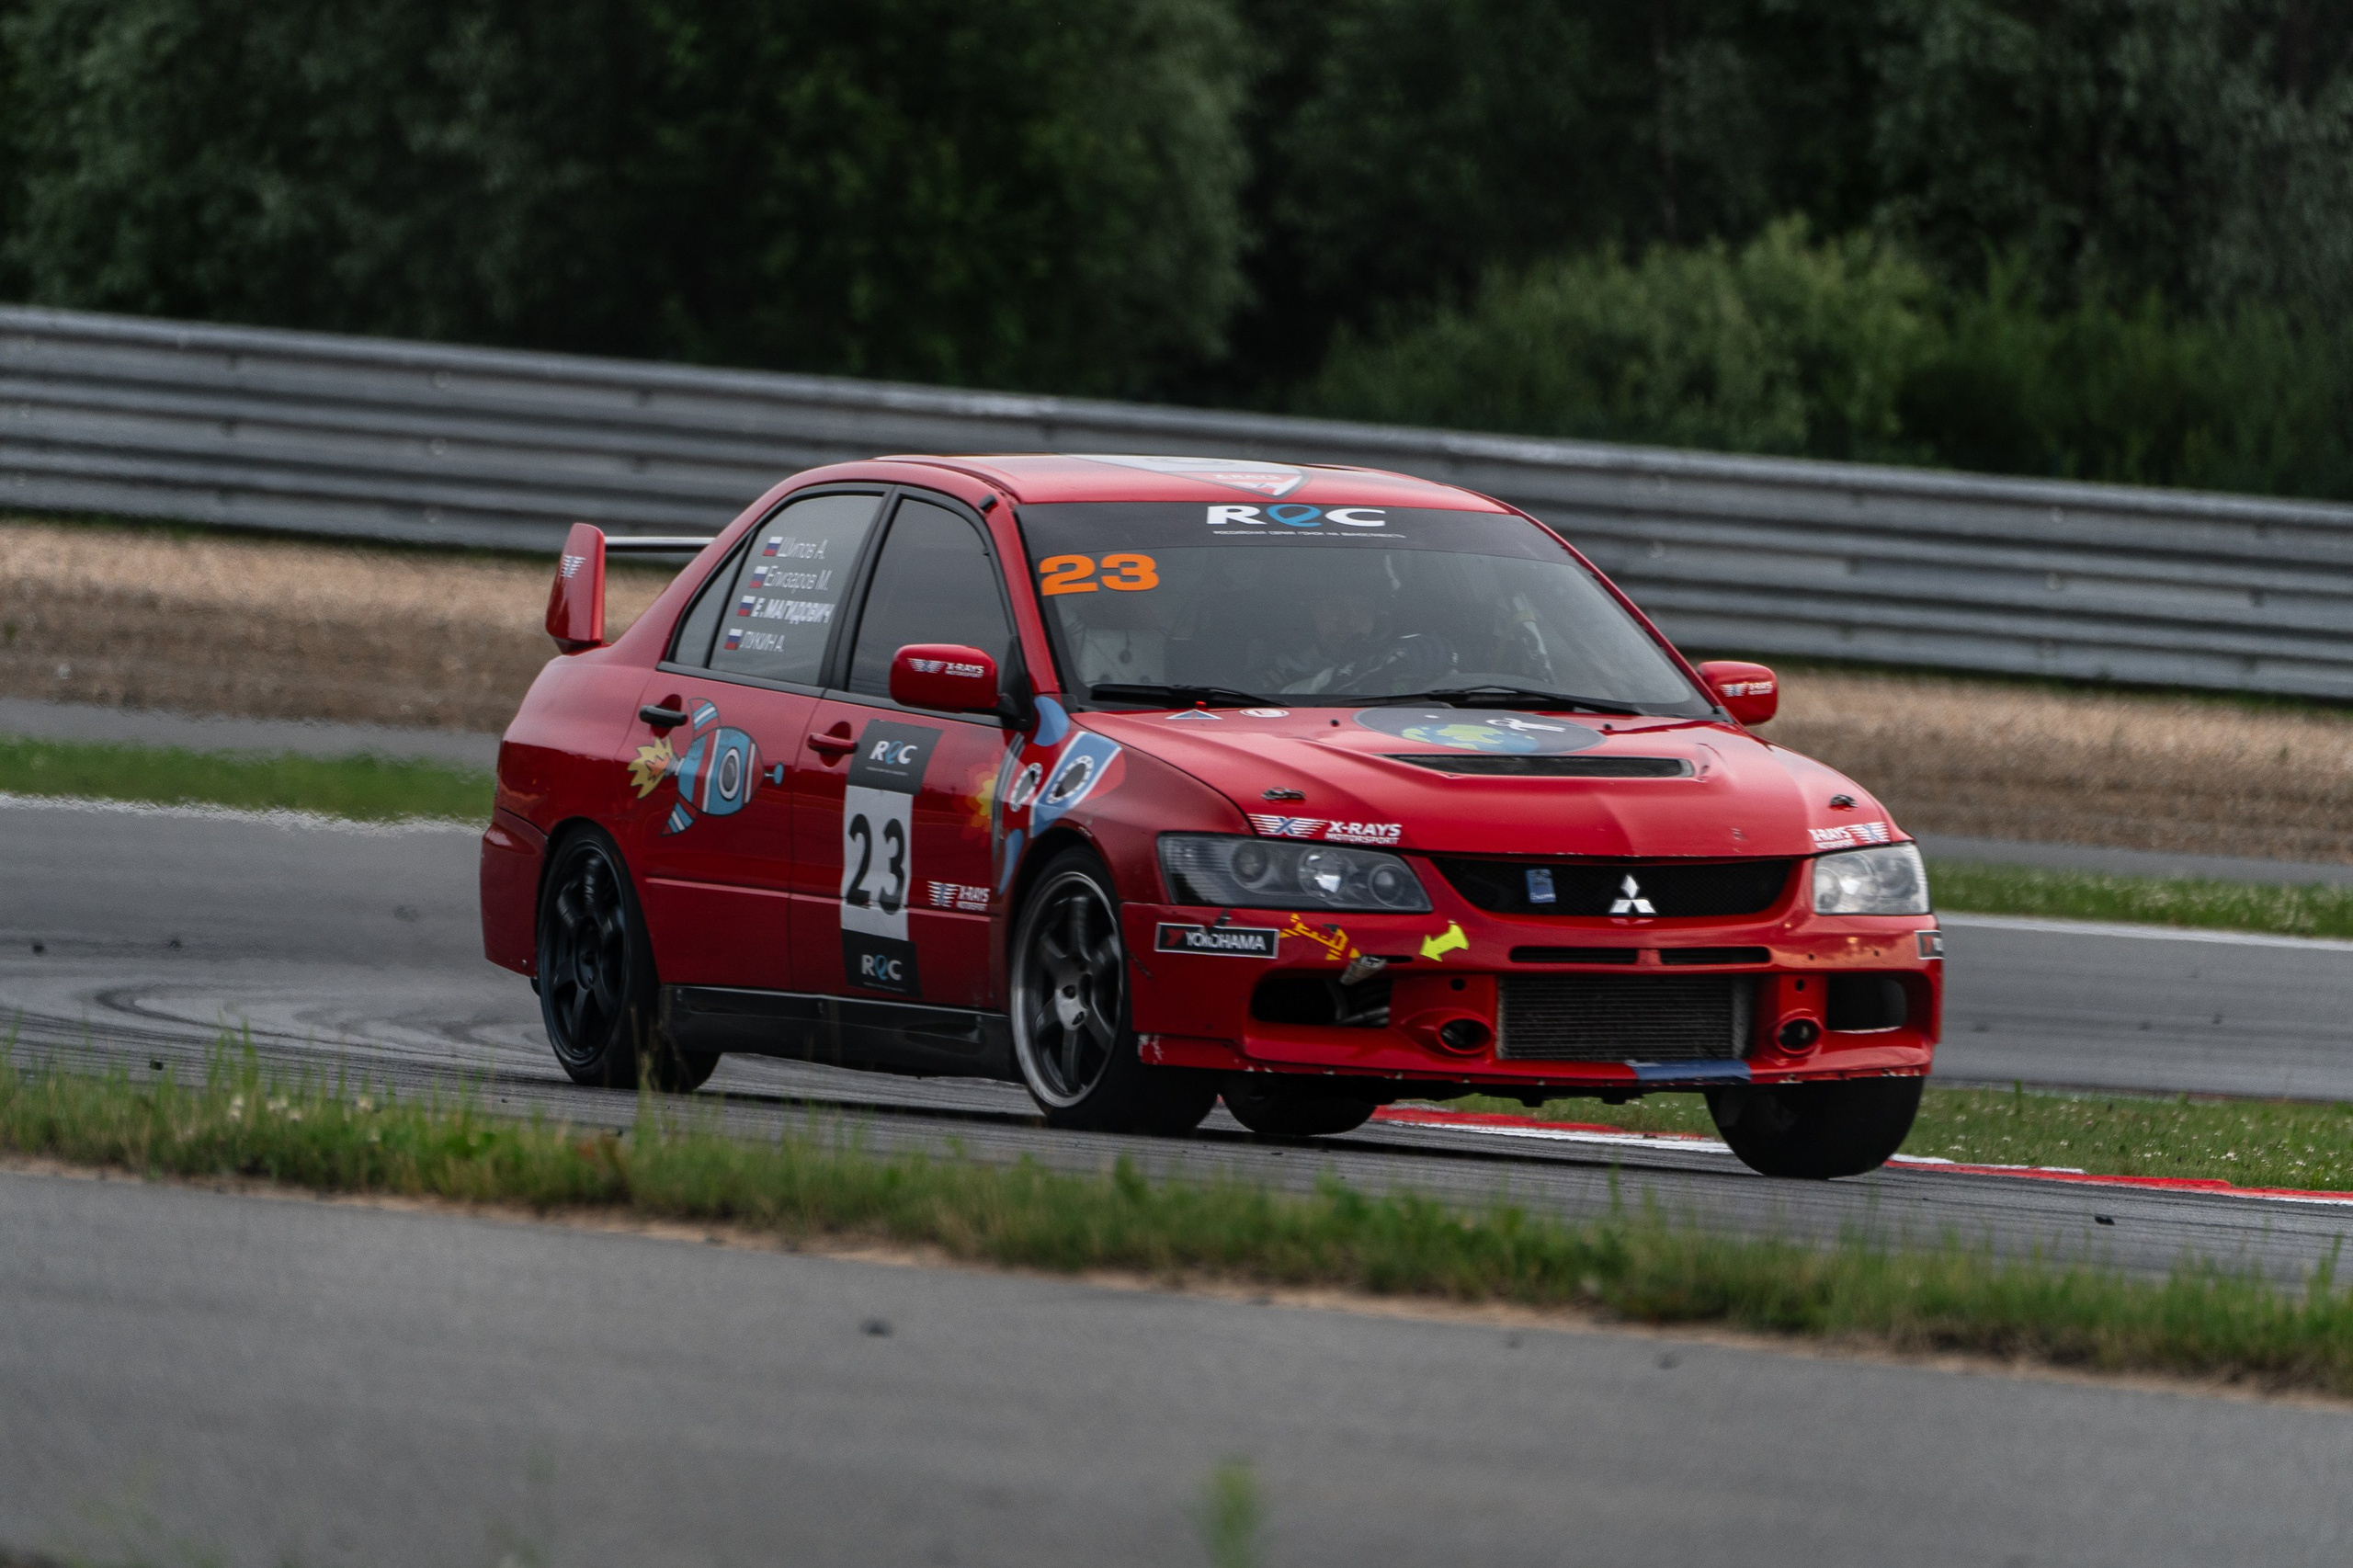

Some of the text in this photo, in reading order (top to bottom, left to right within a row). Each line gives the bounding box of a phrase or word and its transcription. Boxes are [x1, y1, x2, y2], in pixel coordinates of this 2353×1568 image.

[1039, 553, 1160, 597] 23
[1324, 832, 1401, 845] MOTORSPORT
[1326, 821, 1403, 837] X-RAYS
[846, 813, 906, 915] 23
[1186, 931, 1267, 951] YOKOHAMA
